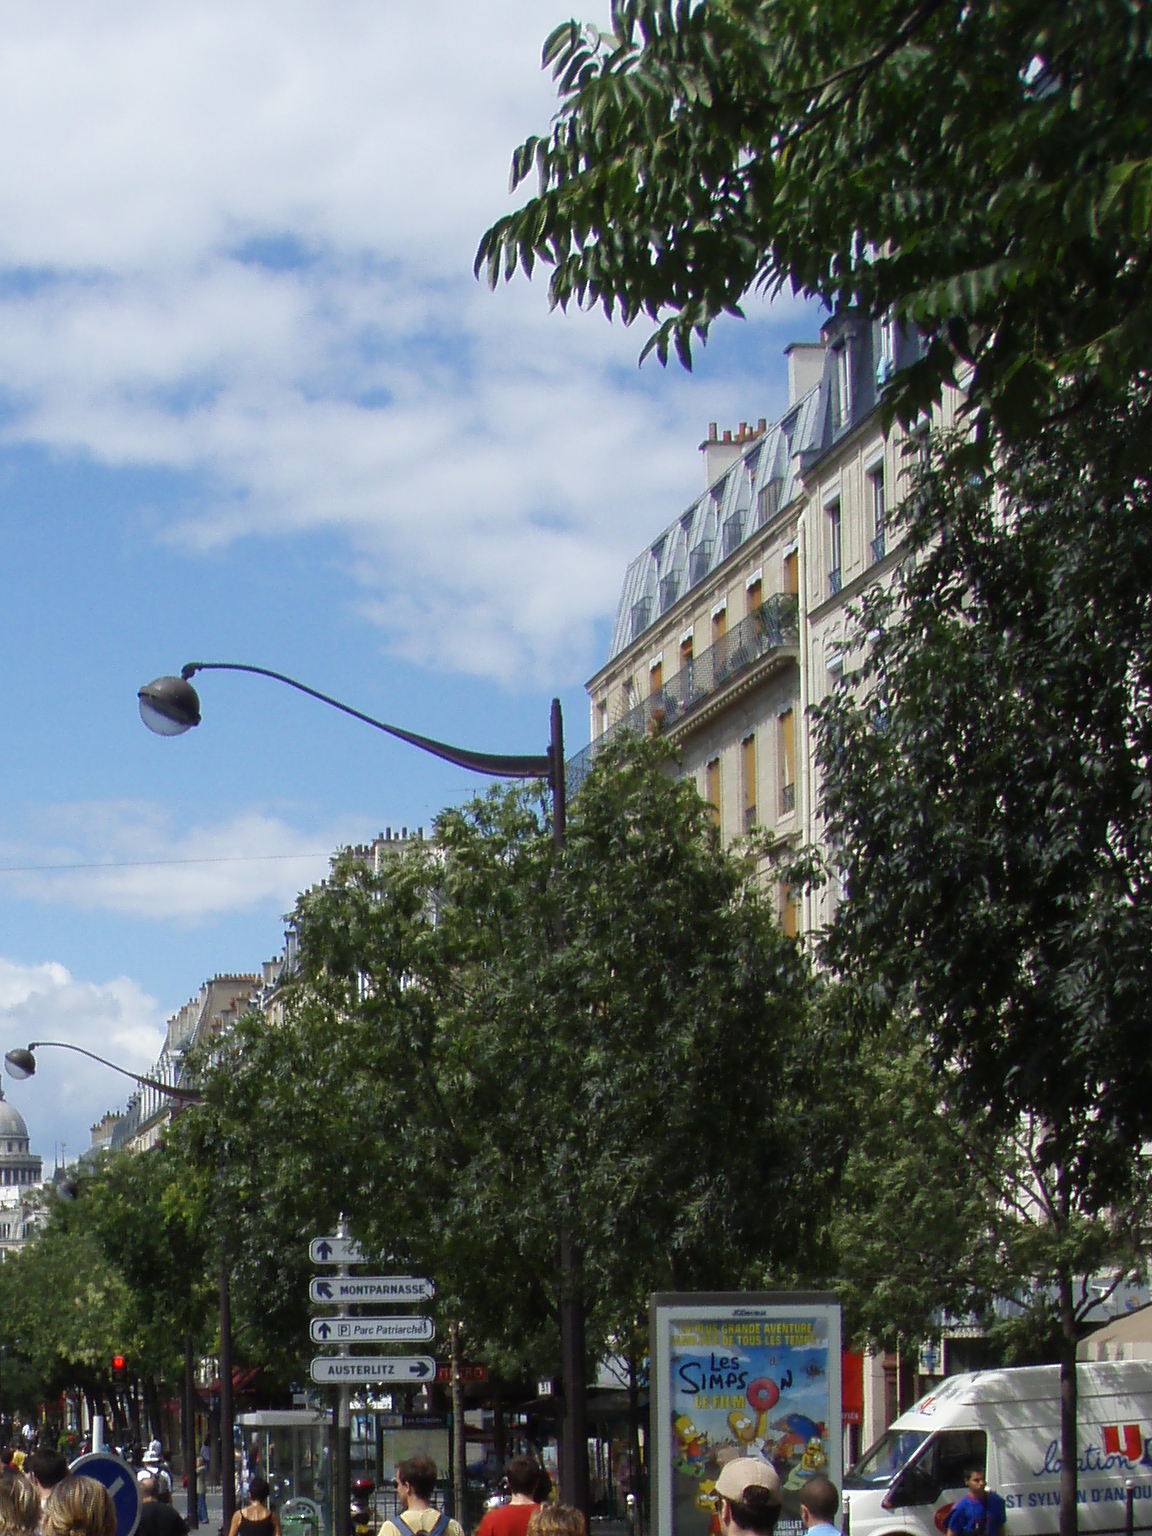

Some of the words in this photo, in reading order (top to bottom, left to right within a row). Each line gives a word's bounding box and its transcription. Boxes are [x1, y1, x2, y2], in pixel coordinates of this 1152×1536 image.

[340, 1284, 425, 1295] MONTPARNASSE
[354, 1325, 374, 1335] Parc
[721, 1323, 761, 1334] GRANDE
[764, 1323, 813, 1334] AVENTURE
[722, 1335, 734, 1346] DE
[737, 1335, 762, 1346] TOUS
[765, 1335, 782, 1346] LES
[710, 1352, 740, 1371] Les
[328, 1365, 395, 1375] AUSTERLITZ
[694, 1396, 708, 1410] LE
[712, 1396, 746, 1410] FILM
[1033, 1440, 1137, 1476] loation
[1006, 1494, 1024, 1508] ST
[1028, 1489, 1087, 1507] SYLVN
[1091, 1485, 1152, 1502] D'ANOU
[777, 1520, 803, 1529] JUILLET
